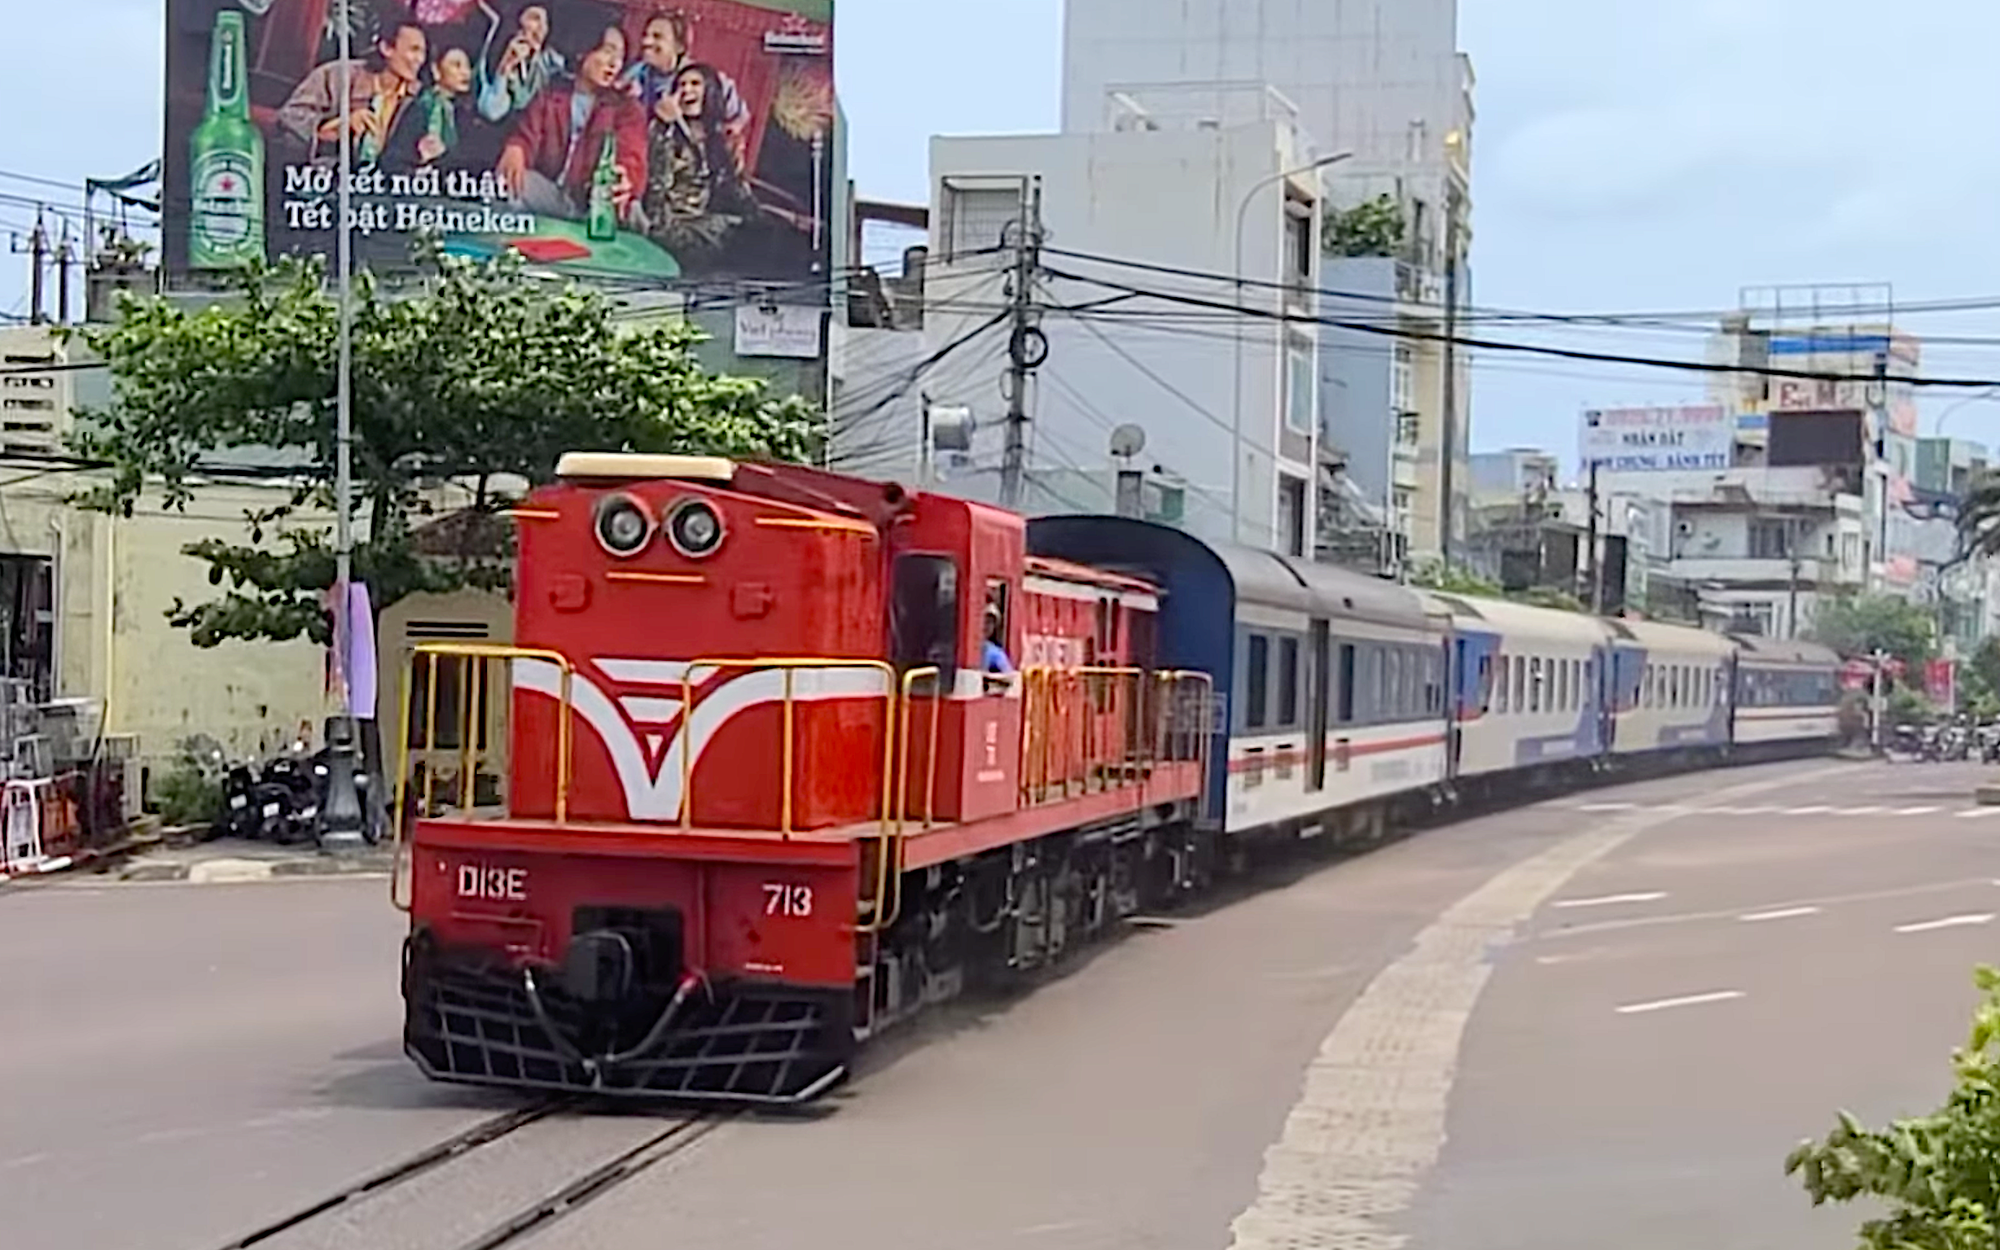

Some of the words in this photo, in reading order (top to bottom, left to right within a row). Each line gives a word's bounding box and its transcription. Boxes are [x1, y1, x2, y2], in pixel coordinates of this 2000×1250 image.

[284, 196, 332, 229] Tết
[394, 202, 537, 234] Heineken
[458, 864, 528, 900] D13E
[762, 883, 813, 917] 713
